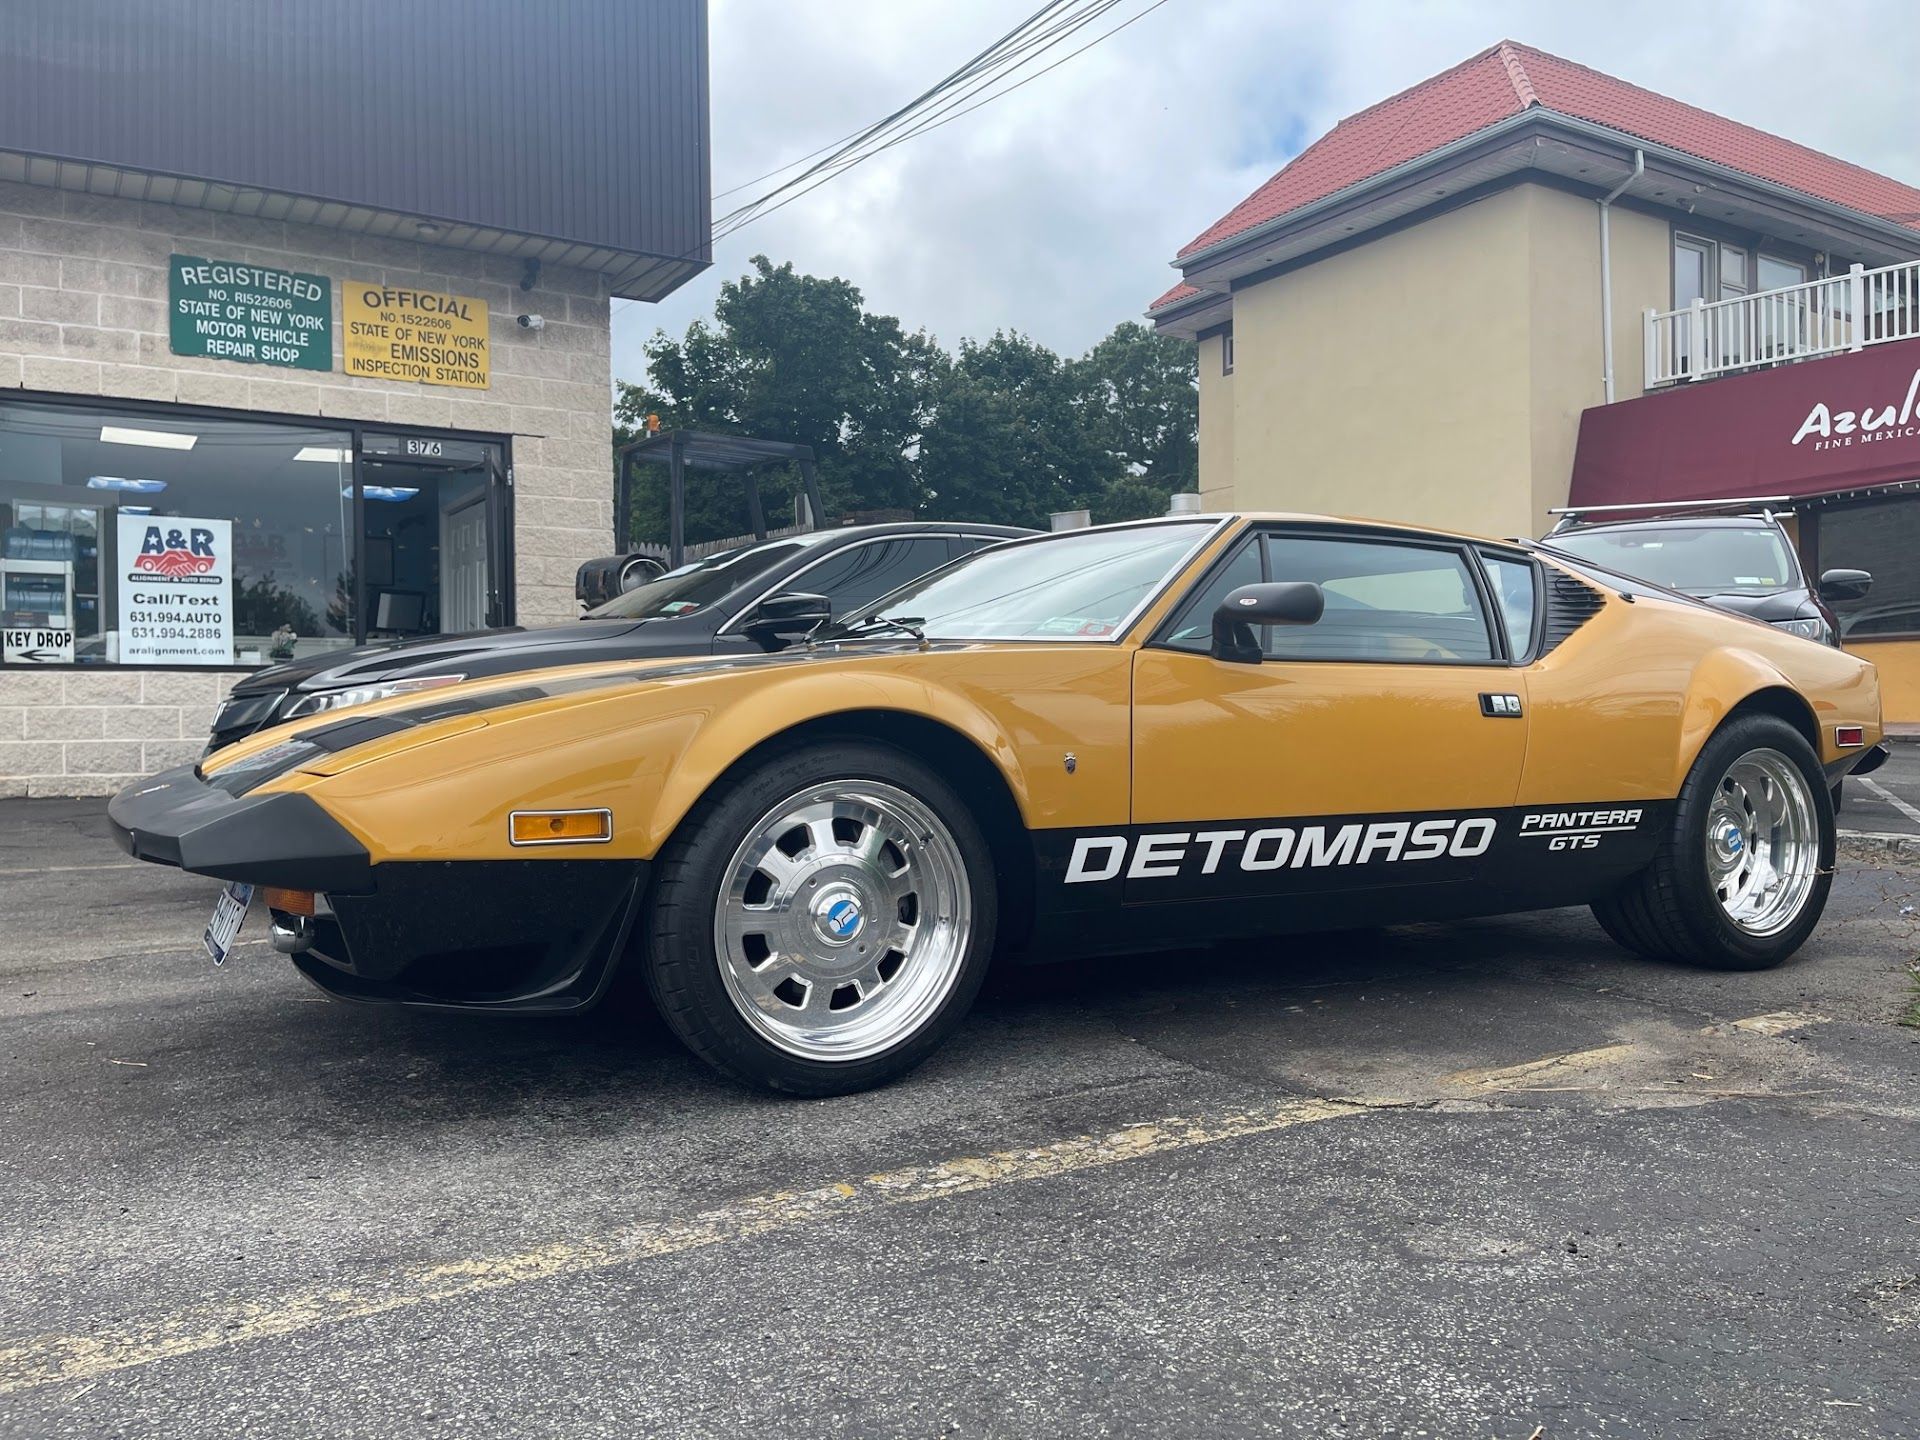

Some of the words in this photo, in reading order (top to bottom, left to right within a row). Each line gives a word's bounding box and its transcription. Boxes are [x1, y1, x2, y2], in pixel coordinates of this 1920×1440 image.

[181, 266, 322, 301] REGISTERED
[208, 288, 229, 301] NO.
[179, 299, 220, 318] STATE
[226, 305, 245, 320] OF
[251, 308, 282, 325] NEW
[288, 313, 324, 331] YORK
[363, 290, 473, 322] OFFICIAL
[380, 311, 399, 324] NO.
[401, 314, 452, 330] 1522606
[196, 320, 246, 339] MOTOR
[252, 326, 309, 347] VEHICLE
[350, 322, 389, 338] STATE
[395, 327, 413, 341] OF
[418, 331, 447, 345] NEW
[451, 334, 486, 351] YORK
[206, 339, 255, 358] REPAIR
[261, 347, 300, 363] SHOP
[391, 343, 479, 369] EMISSIONS
[352, 358, 430, 378] INSPECTION
[436, 367, 486, 384] STATION
[1791, 368, 1920, 445] Azul
[409, 441, 440, 455] 376
[1815, 437, 1852, 451] FINE
[140, 526, 215, 557] A&R
[133, 593, 219, 606] Call/Text
[130, 611, 222, 624] 631.994.AUTO
[6, 632, 33, 648] KEY
[37, 632, 72, 648] DROP
[131, 627, 221, 639] 631.994.2886
[129, 646, 225, 656] aralignment.com
[1521, 809, 1643, 830] PANTERA
[1063, 818, 1497, 884] DETOMASO
[1548, 834, 1602, 851] GTS
